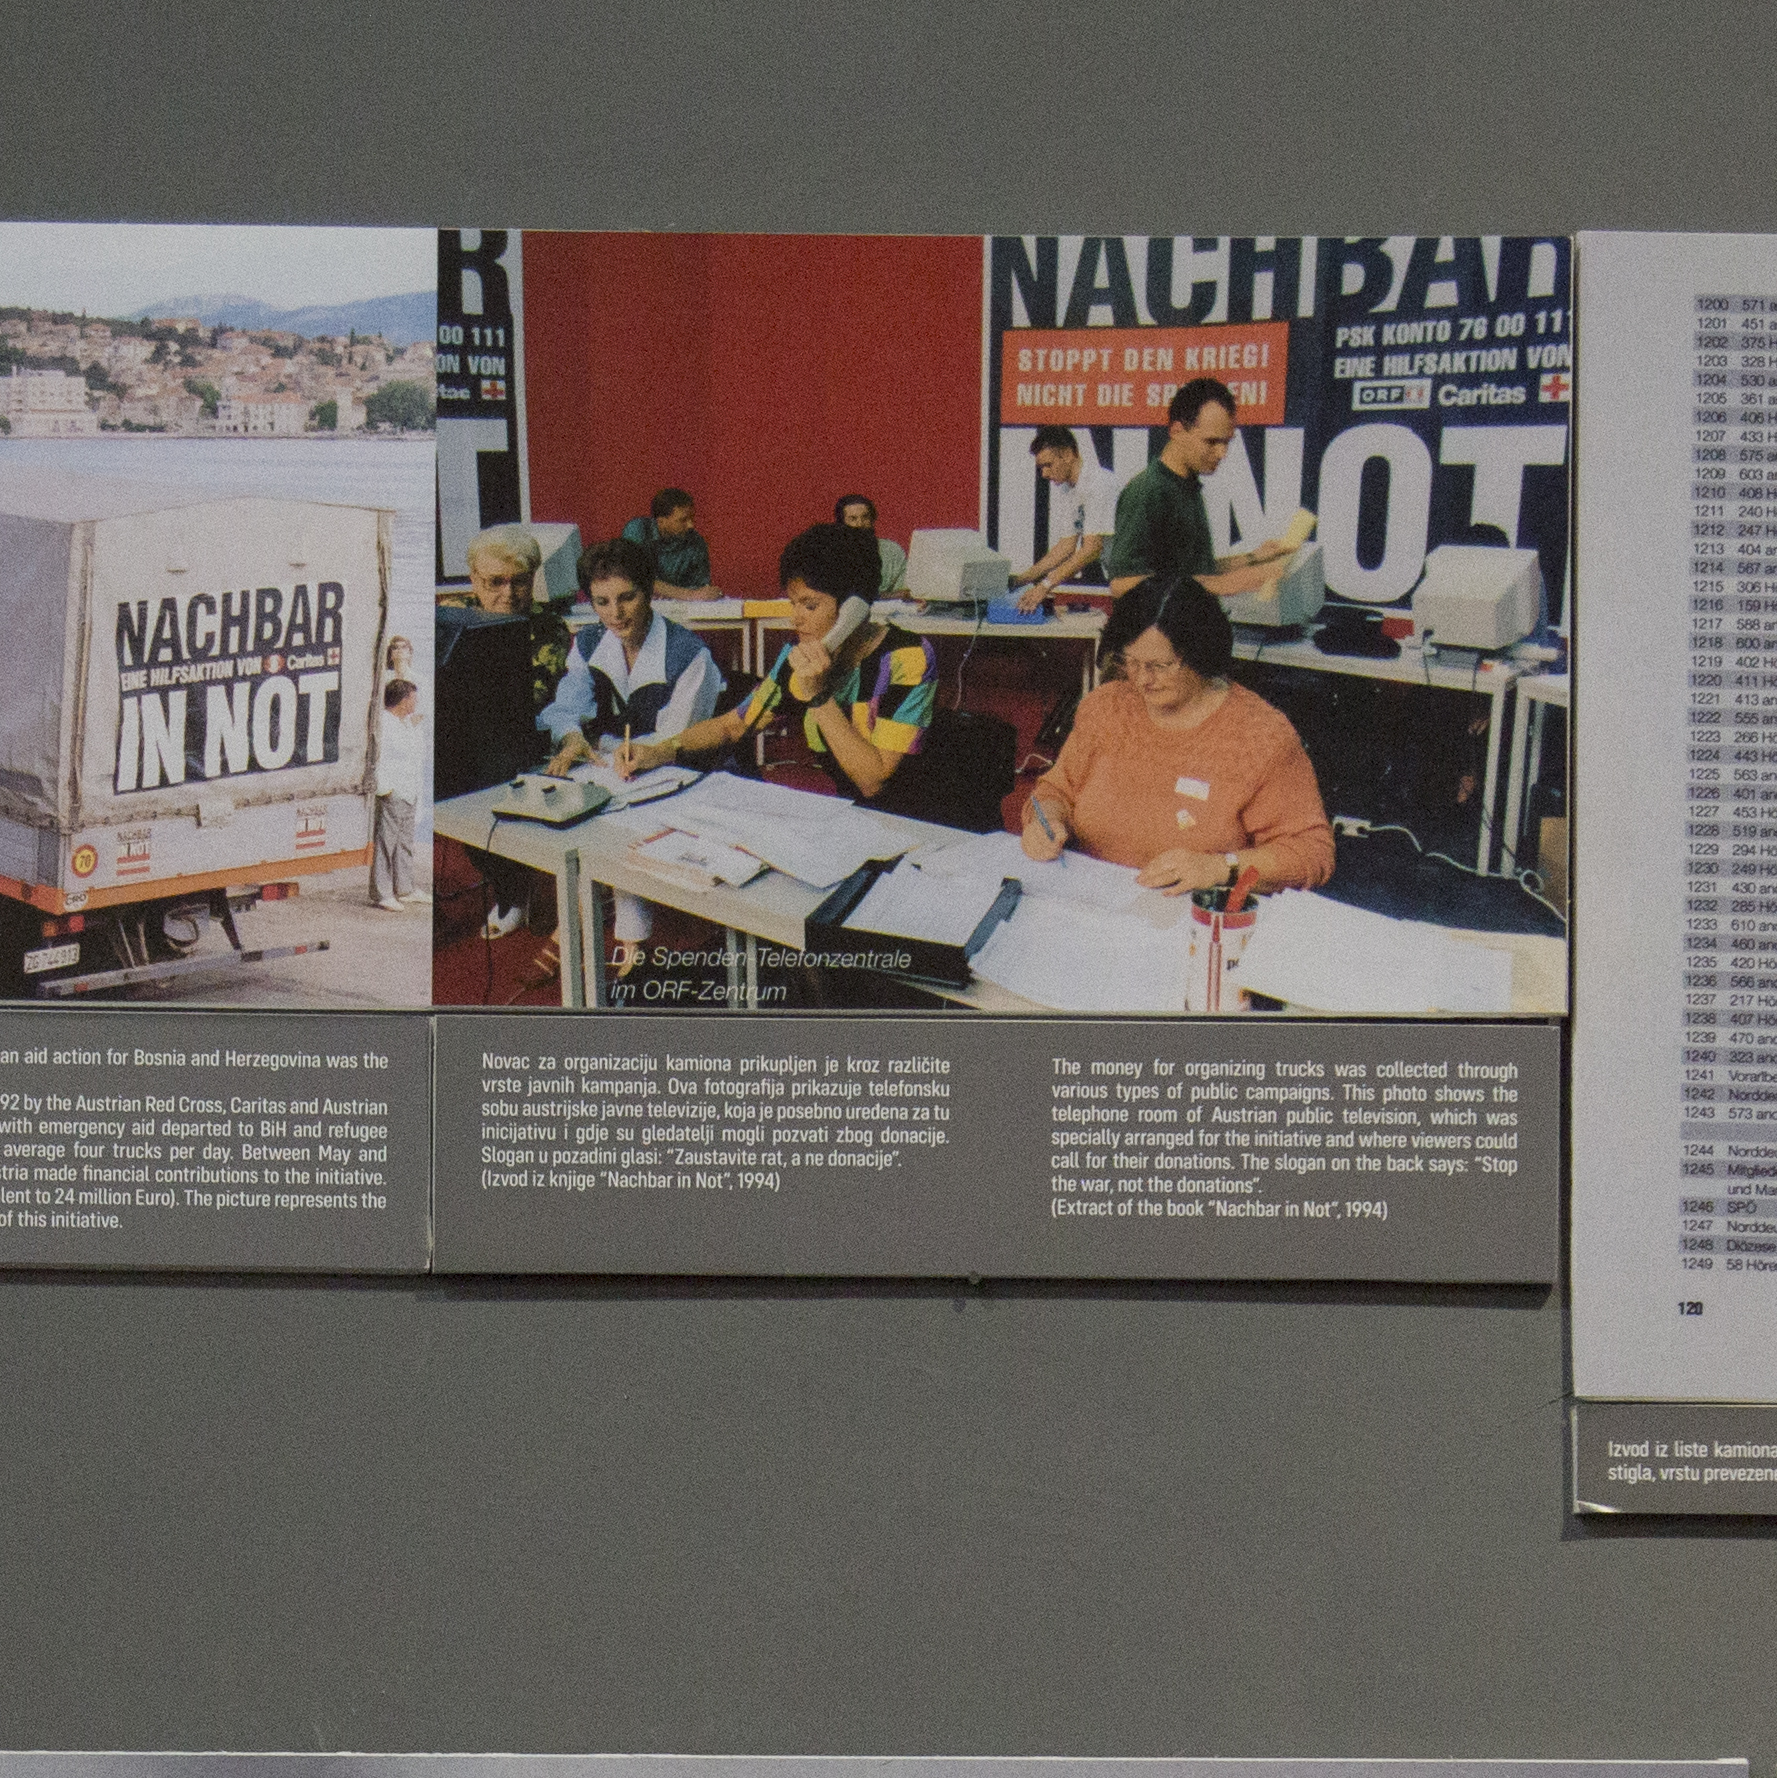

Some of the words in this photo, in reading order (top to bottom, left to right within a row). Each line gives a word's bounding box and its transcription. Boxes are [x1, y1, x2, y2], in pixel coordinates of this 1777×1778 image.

[1334, 326, 1376, 349] PSK
[1381, 321, 1451, 346] KONTO
[1494, 314, 1525, 338] 00
[1534, 310, 1572, 334] 11
[1698, 318, 1727, 329] 1201
[1742, 318, 1764, 329] 451
[471, 327, 506, 347] 111
[468, 354, 507, 376] VON
[1017, 346, 1112, 374] STOPPT
[1123, 346, 1174, 372] DEN
[1184, 343, 1270, 370] KRIEG!
[1333, 356, 1377, 379] EINE
[1382, 348, 1516, 377] HILFSAKTION
[1525, 343, 1571, 370] VON
[1015, 383, 1088, 408] NICHT
[1095, 383, 1136, 408] DIE
[1144, 379, 1268, 407] SPEN!
[1358, 387, 1404, 404] ORF
[1437, 382, 1527, 408] Caritas
[115, 580, 345, 668] NACHBAR
[120, 671, 148, 691] EINE
[150, 658, 234, 688] HILFSAKTION
[236, 656, 263, 676] VON
[287, 653, 324, 671] Caritas
[115, 689, 188, 793] IN
[203, 671, 340, 780] NOT
[611, 946, 646, 967] Die
[652, 946, 912, 970] Spenden-Telefonzentrale
[610, 978, 636, 1000] im
[642, 980, 788, 1001] ORF-Zentrum
[23, 1046, 49, 1066] aid
[51, 1047, 102, 1066] action
[106, 1046, 130, 1066] for
[133, 1048, 187, 1067] Bosnia
[190, 1049, 221, 1068] and
[224, 1049, 322, 1072] Herzegovina
[325, 1054, 359, 1070] was
[362, 1050, 390, 1070] the
[1052, 1057, 1082, 1076] The
[1090, 1061, 1144, 1080] money
[1152, 1057, 1176, 1077] for
[1183, 1059, 1267, 1081] organizing
[1274, 1060, 1326, 1079] trucks
[1333, 1063, 1368, 1079] was
[1375, 1060, 1449, 1079] collected
[1456, 1060, 1519, 1084] through
[1678, 1300, 1704, 1316] 120
[1607, 1463, 1657, 1486] stigla,
[1658, 1465, 1701, 1482] vrstu
